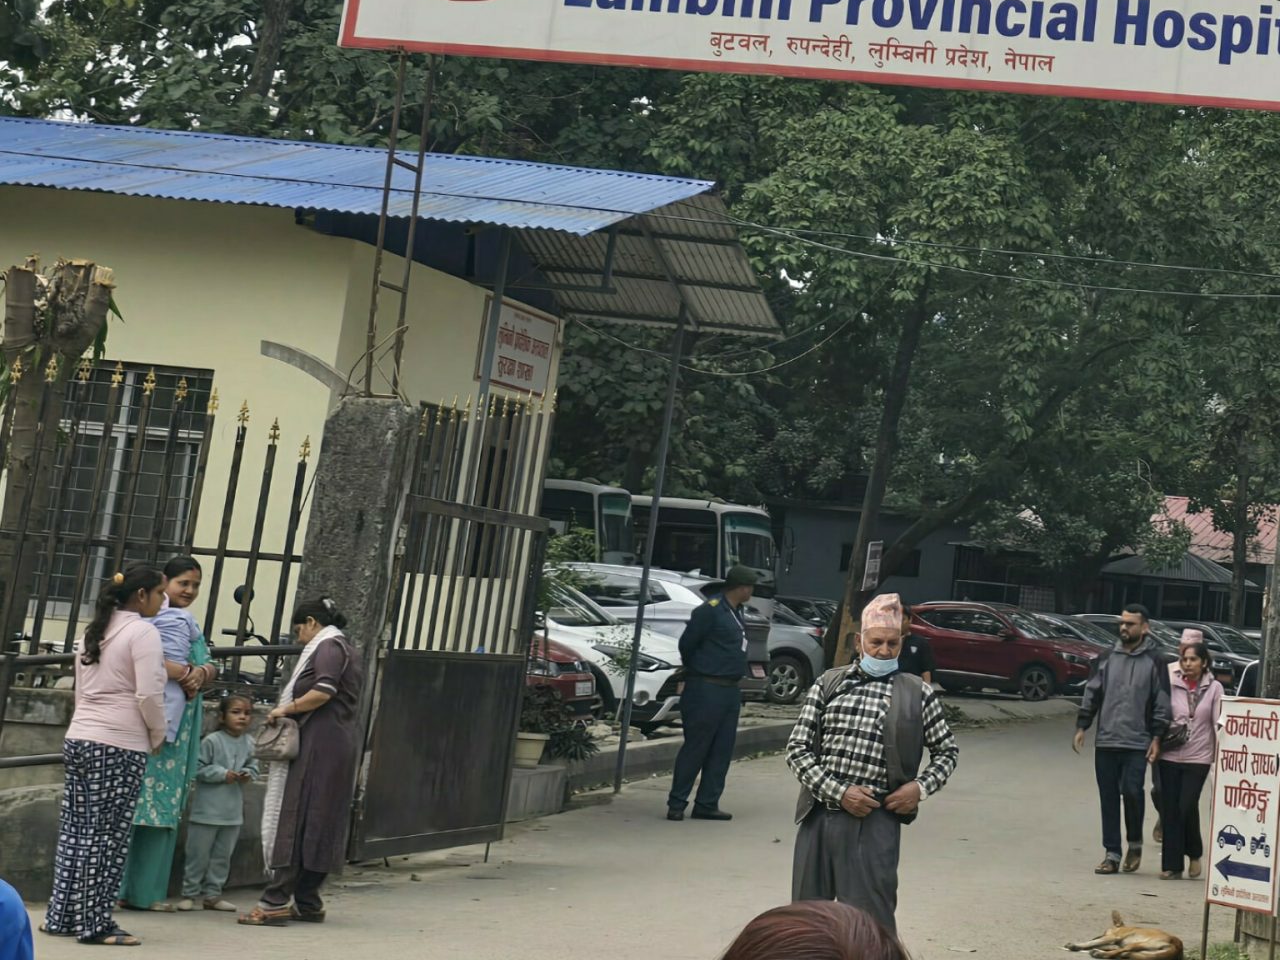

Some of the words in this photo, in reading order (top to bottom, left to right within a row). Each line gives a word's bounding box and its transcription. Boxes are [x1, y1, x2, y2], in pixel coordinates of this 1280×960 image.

[710, 32, 773, 57] बुटवल,
[868, 37, 937, 68] लुम्बिनी
[945, 44, 991, 73] प्रदेश,
[1004, 48, 1055, 72] नेपाल
[1225, 709, 1280, 741] कर्मचारी
[1221, 744, 1249, 774] सवारी
